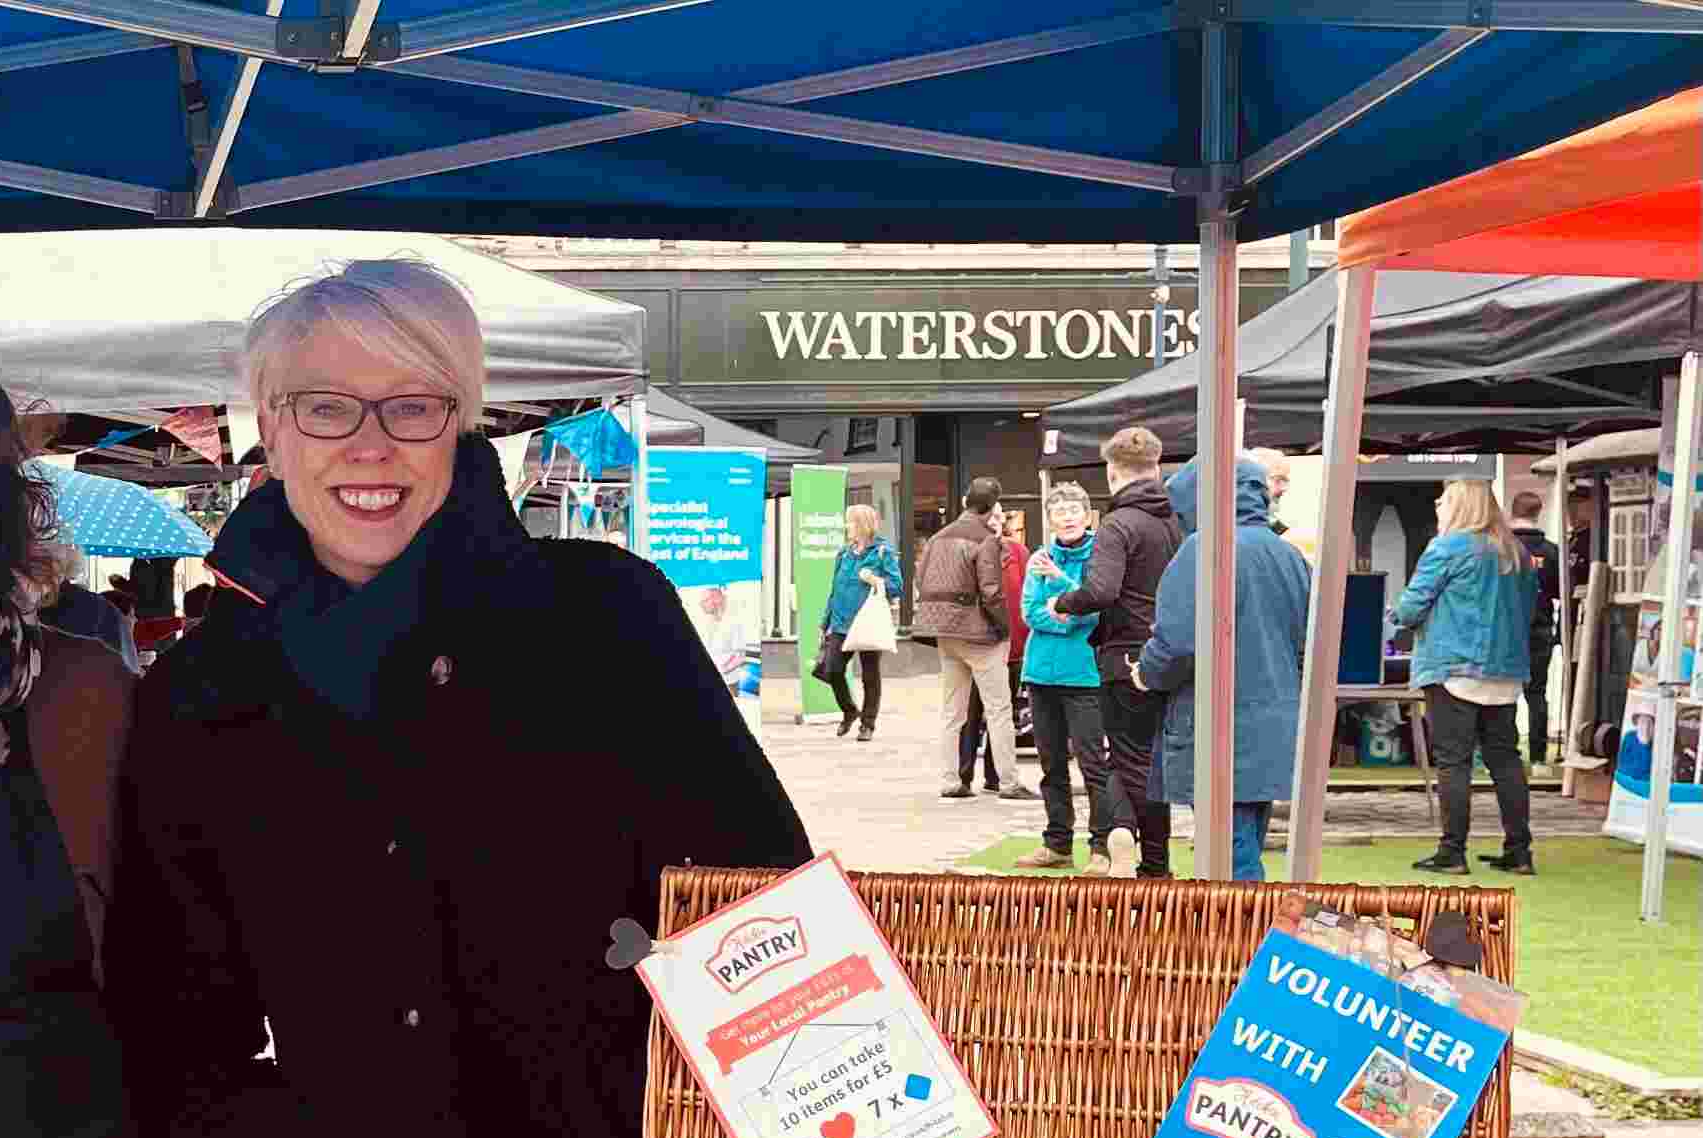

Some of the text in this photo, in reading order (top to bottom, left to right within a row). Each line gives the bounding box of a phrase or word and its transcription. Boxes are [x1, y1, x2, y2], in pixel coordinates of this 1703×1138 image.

[649, 501, 709, 516] pecialist
[649, 517, 728, 532] eurological
[649, 532, 742, 545] ervices in the
[675, 548, 691, 561] of
[693, 548, 750, 563] England
[718, 930, 796, 983] PANTRY
[1267, 955, 1475, 1074] VOLUNTEER
[1231, 1017, 1329, 1084] WITH
[786, 1042, 885, 1101] You can take
[779, 1060, 893, 1131] 10 items for £5
[867, 1093, 904, 1119] 7 x
